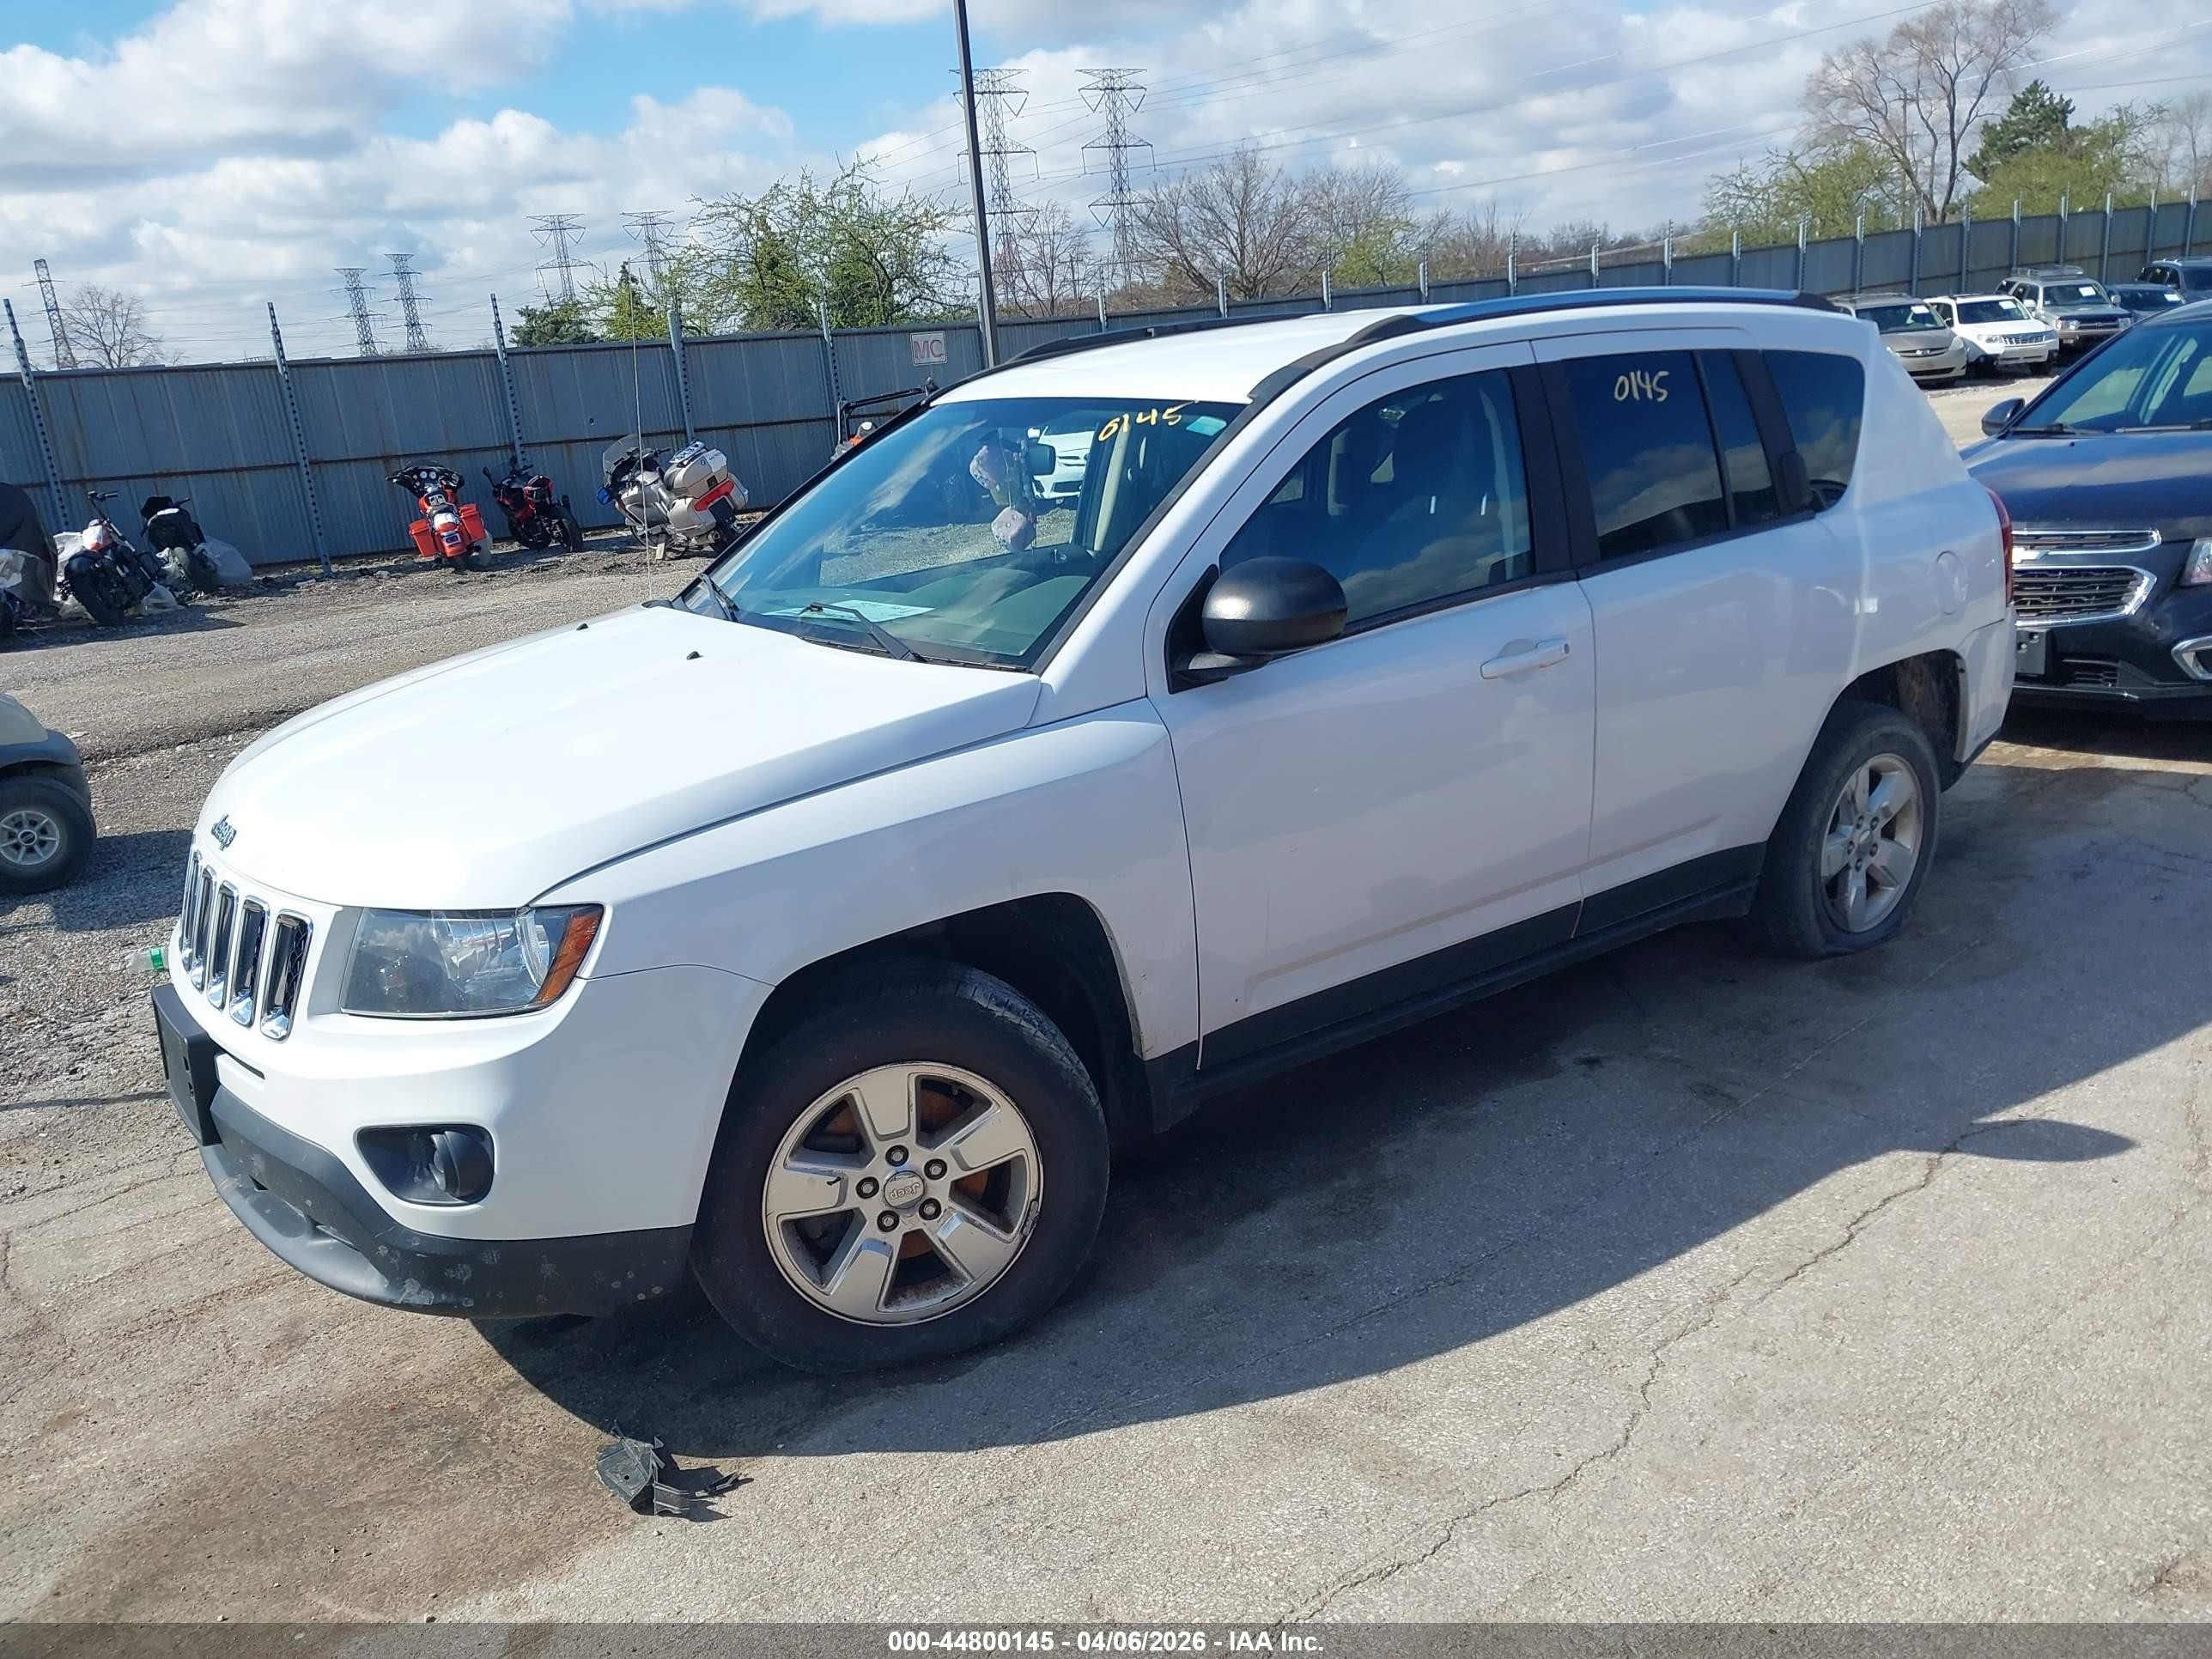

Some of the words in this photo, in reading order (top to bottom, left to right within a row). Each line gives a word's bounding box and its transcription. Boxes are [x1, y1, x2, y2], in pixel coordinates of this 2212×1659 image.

[913, 339, 945, 359] MC
[1613, 369, 1669, 402] 0145
[889, 1182, 921, 1200] Jeep
